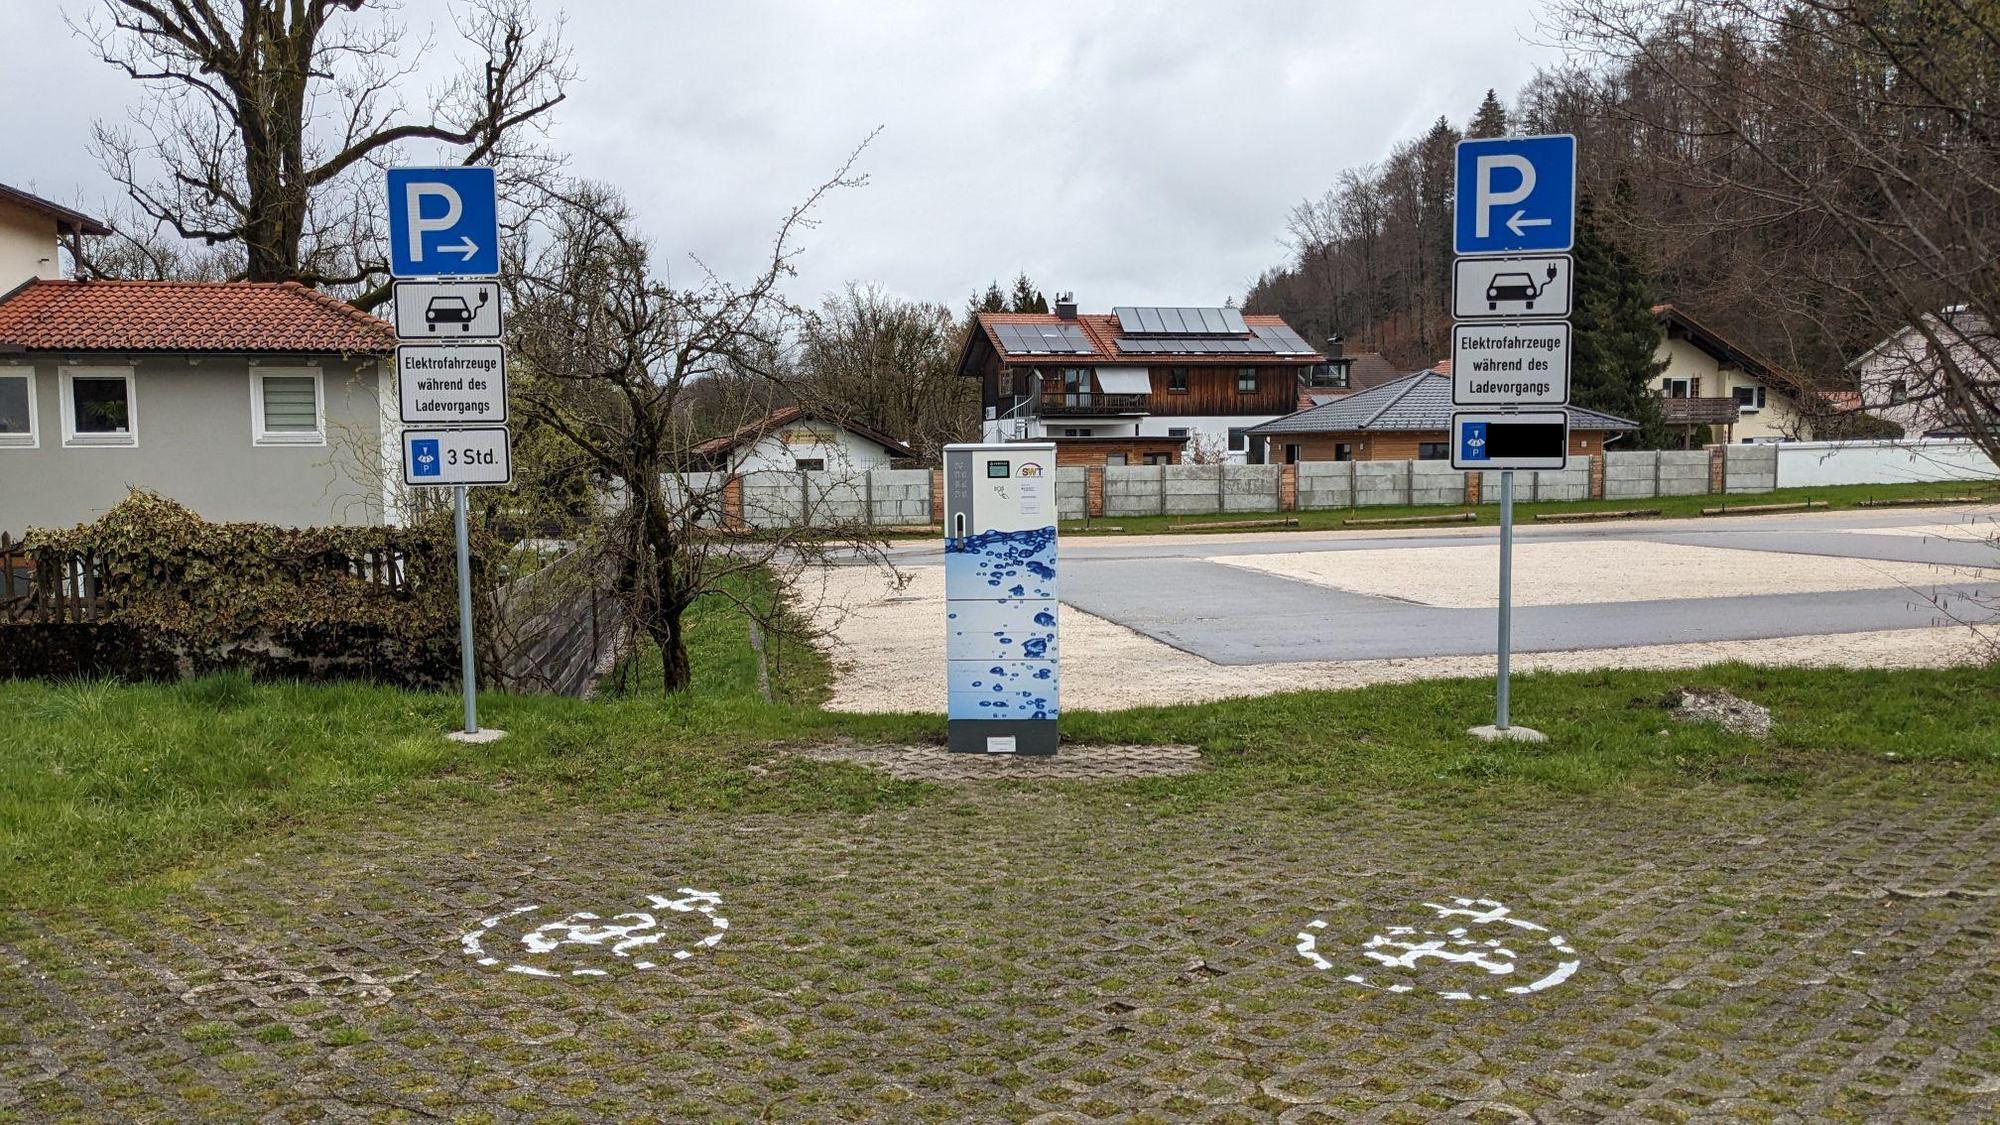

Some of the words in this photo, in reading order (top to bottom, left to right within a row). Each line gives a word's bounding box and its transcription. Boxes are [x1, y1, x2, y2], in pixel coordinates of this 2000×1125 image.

[1475, 154, 1536, 238] P
[406, 183, 463, 262] P
[1461, 335, 1561, 352] Elektrofahrzeuge
[405, 356, 497, 373] Elektrofahrzeuge
[1472, 357, 1522, 372] während
[1527, 357, 1548, 371] des
[417, 377, 463, 391] während
[468, 377, 487, 391] des
[1469, 380, 1550, 396] Ladevorgangs
[415, 398, 490, 415] Ladevorgangs
[447, 449, 457, 465] 3
[463, 448, 498, 465] Std.
[1472, 448, 1479, 457] P
[423, 464, 430, 473] P
[1022, 467, 1043, 476] SWT
